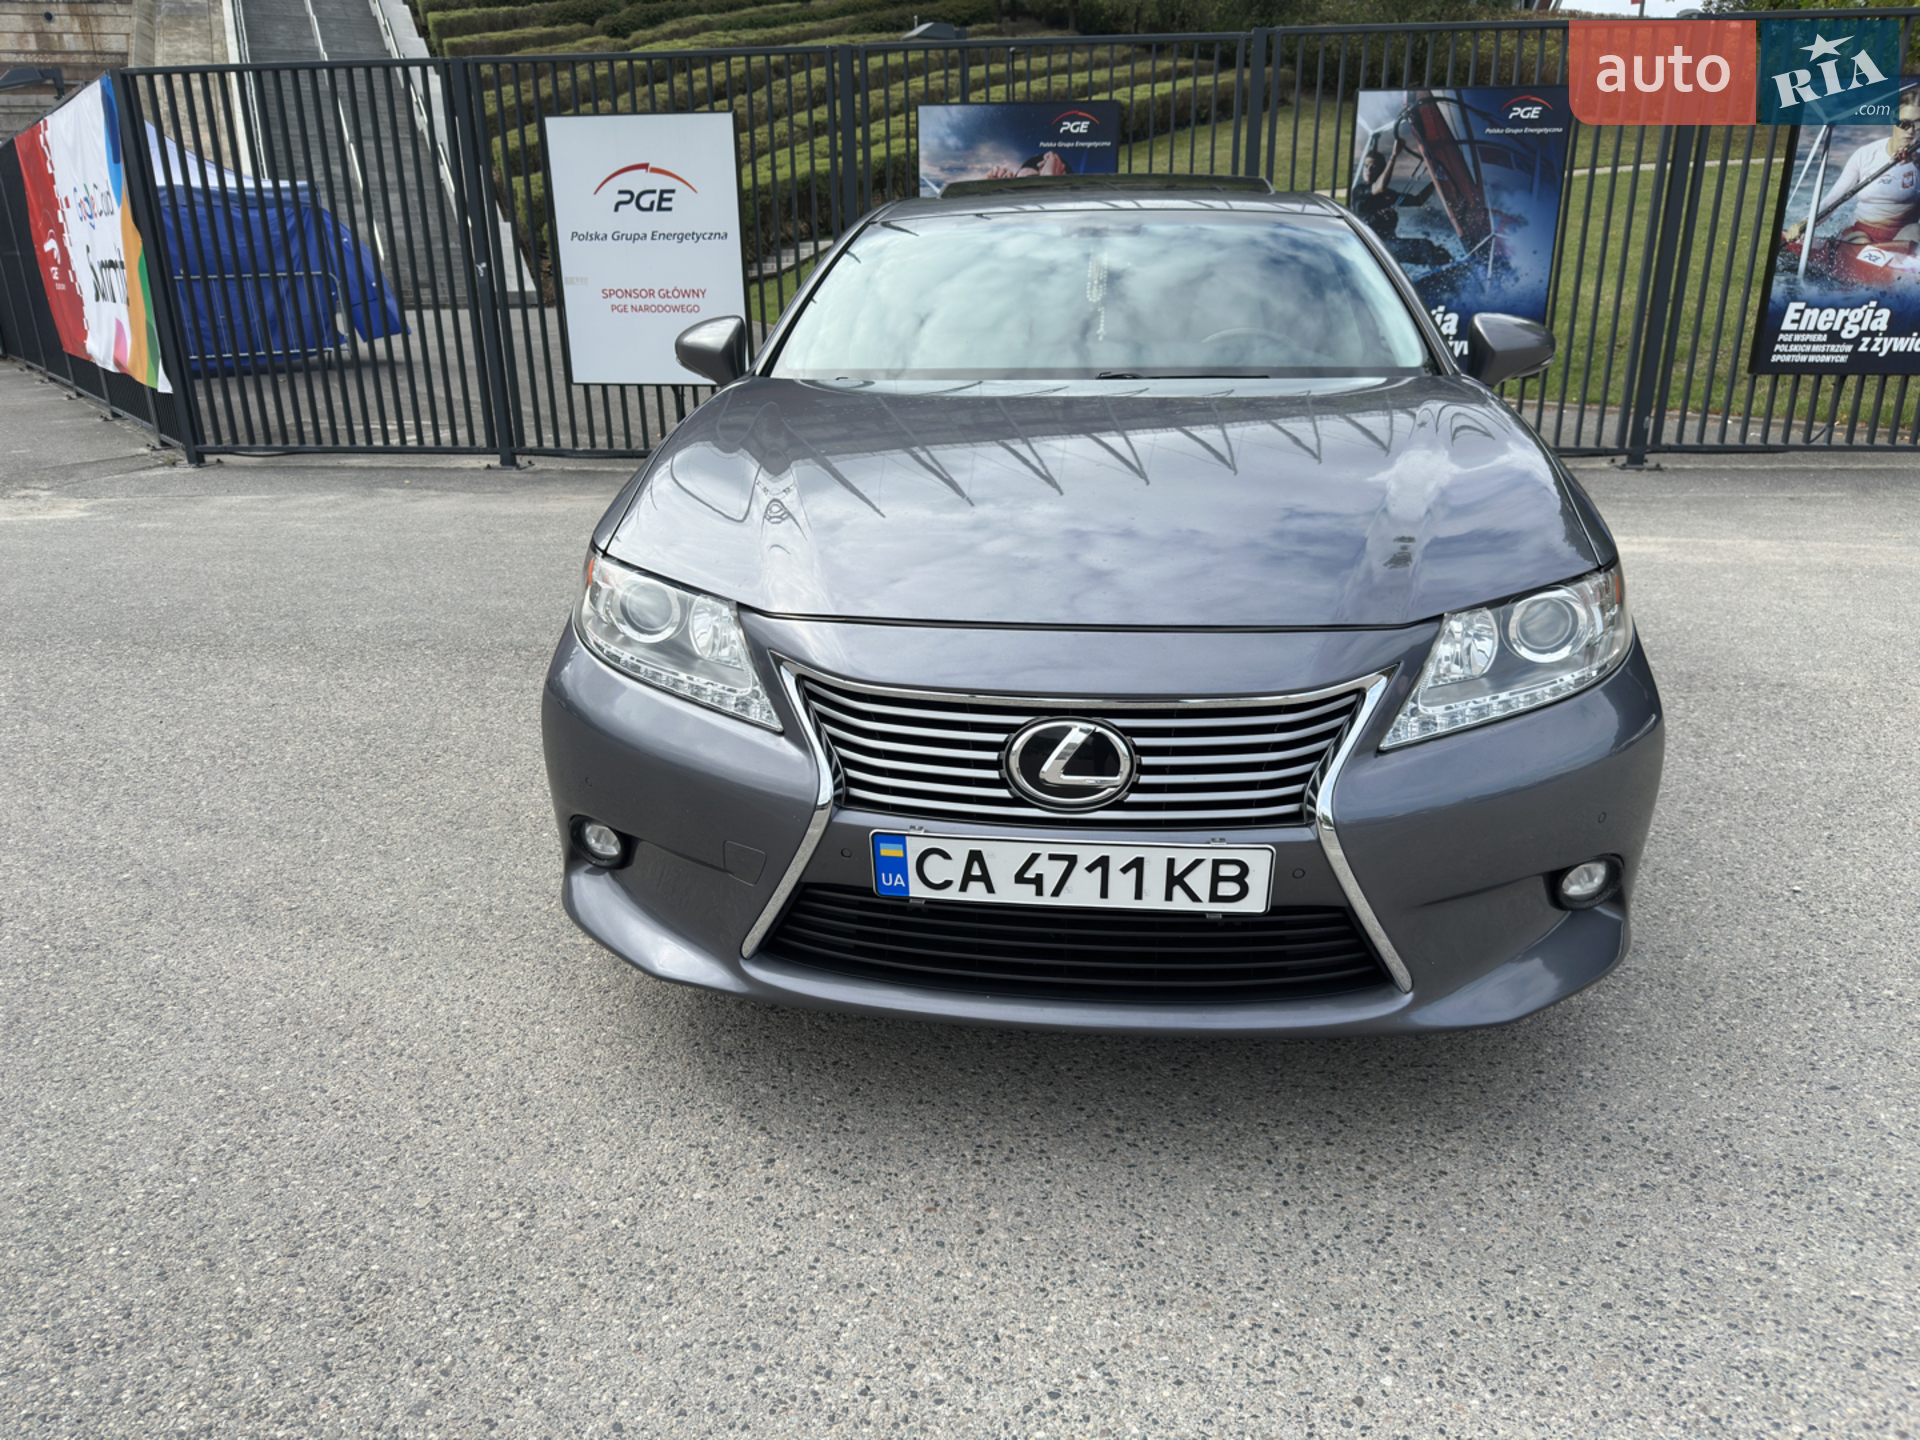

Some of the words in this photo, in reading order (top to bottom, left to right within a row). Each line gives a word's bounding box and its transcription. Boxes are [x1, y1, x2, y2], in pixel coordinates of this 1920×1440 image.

[1508, 106, 1543, 119] PGE
[1059, 121, 1091, 133] PGE
[1505, 127, 1523, 135] Grupa
[613, 189, 676, 212] PGE
[570, 231, 608, 242] Polska
[611, 230, 647, 243] Grupa
[650, 230, 728, 243] Energetyczna
[601, 288, 656, 299] SPONSOR
[657, 286, 707, 299] GŁÓWNY
[611, 304, 629, 313] PGE
[630, 304, 700, 313] NARODOWEGO
[1780, 301, 1891, 339] Energia
[1777, 333, 1793, 342] PGE
[1857, 337, 1871, 352] z
[881, 872, 906, 887] UA
[915, 847, 996, 894] CA
[1014, 852, 1145, 901] 4711
[1164, 857, 1250, 903] KB
